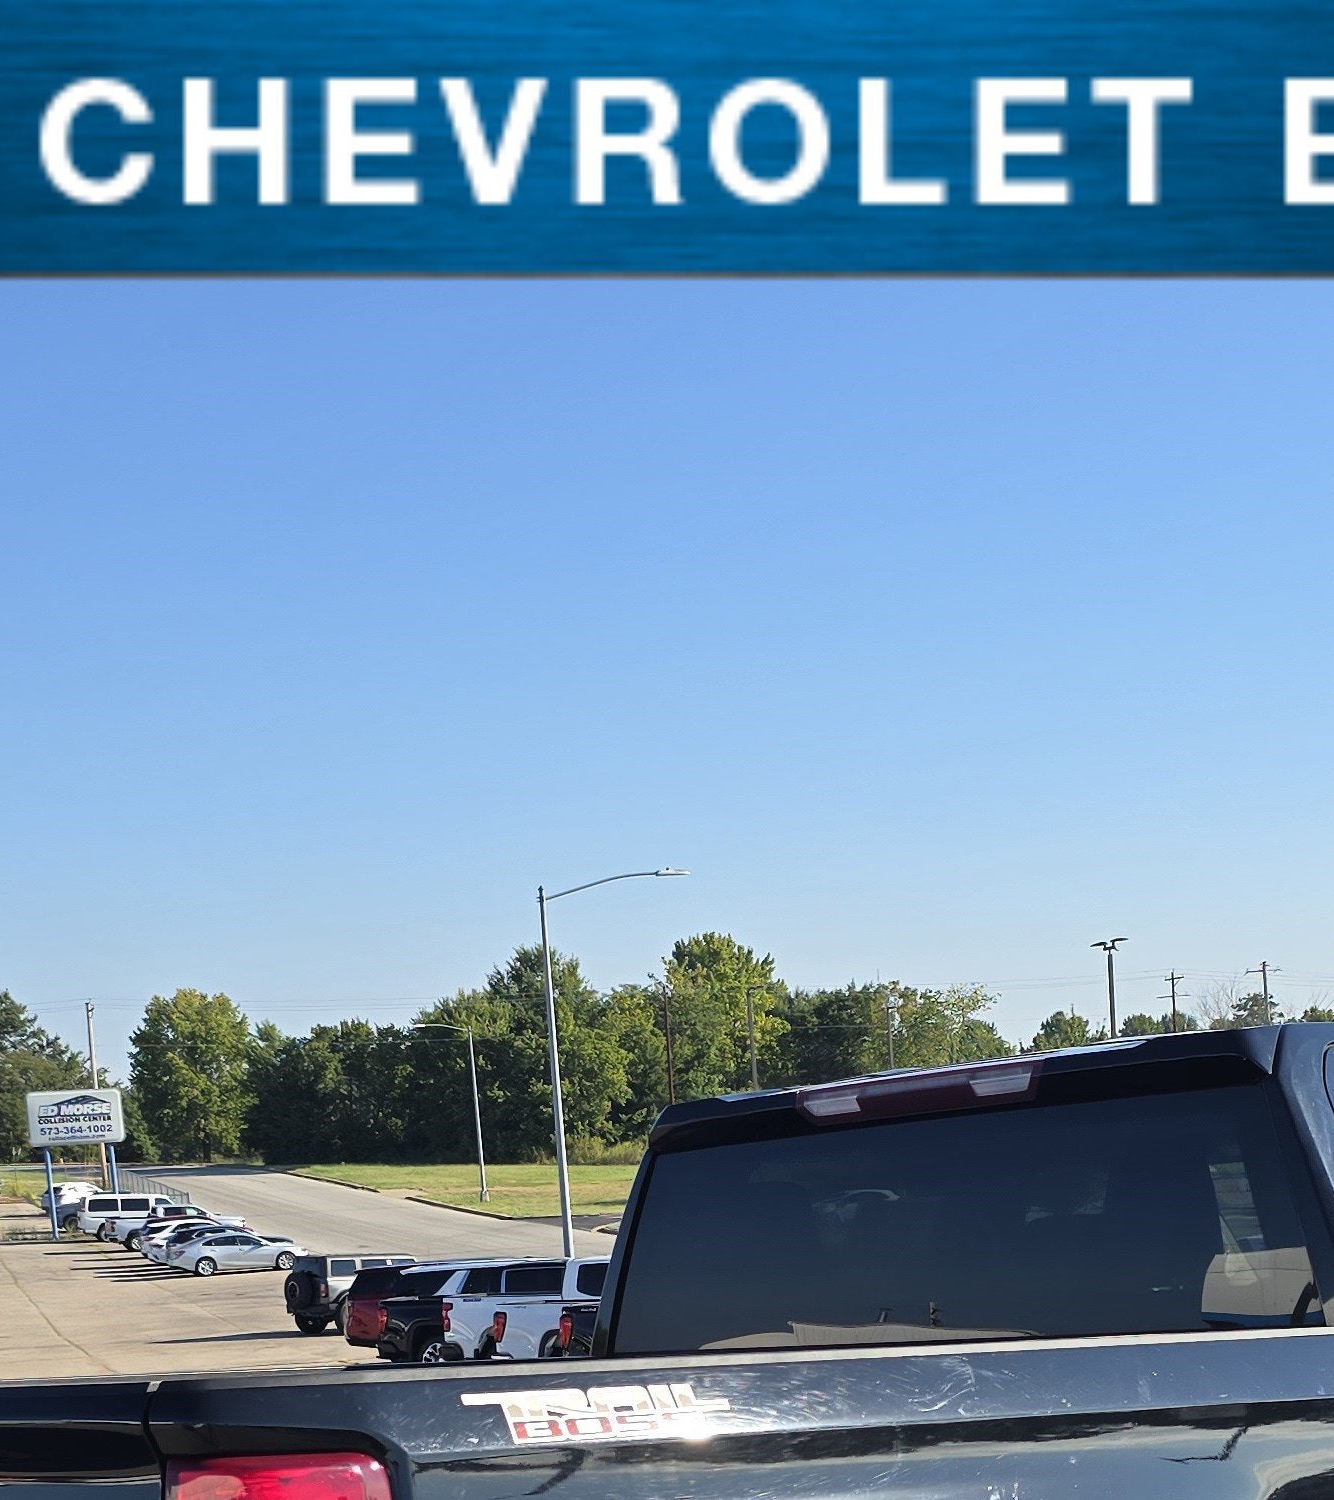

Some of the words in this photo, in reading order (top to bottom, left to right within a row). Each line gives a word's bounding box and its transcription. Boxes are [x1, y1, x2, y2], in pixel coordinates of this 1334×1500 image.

[38, 1105, 58, 1118] ED
[60, 1102, 111, 1116] MORSE
[38, 1116, 81, 1125] COLLISION
[40, 1124, 113, 1136] 573-364-1002
[460, 1383, 731, 1418] TRAIL
